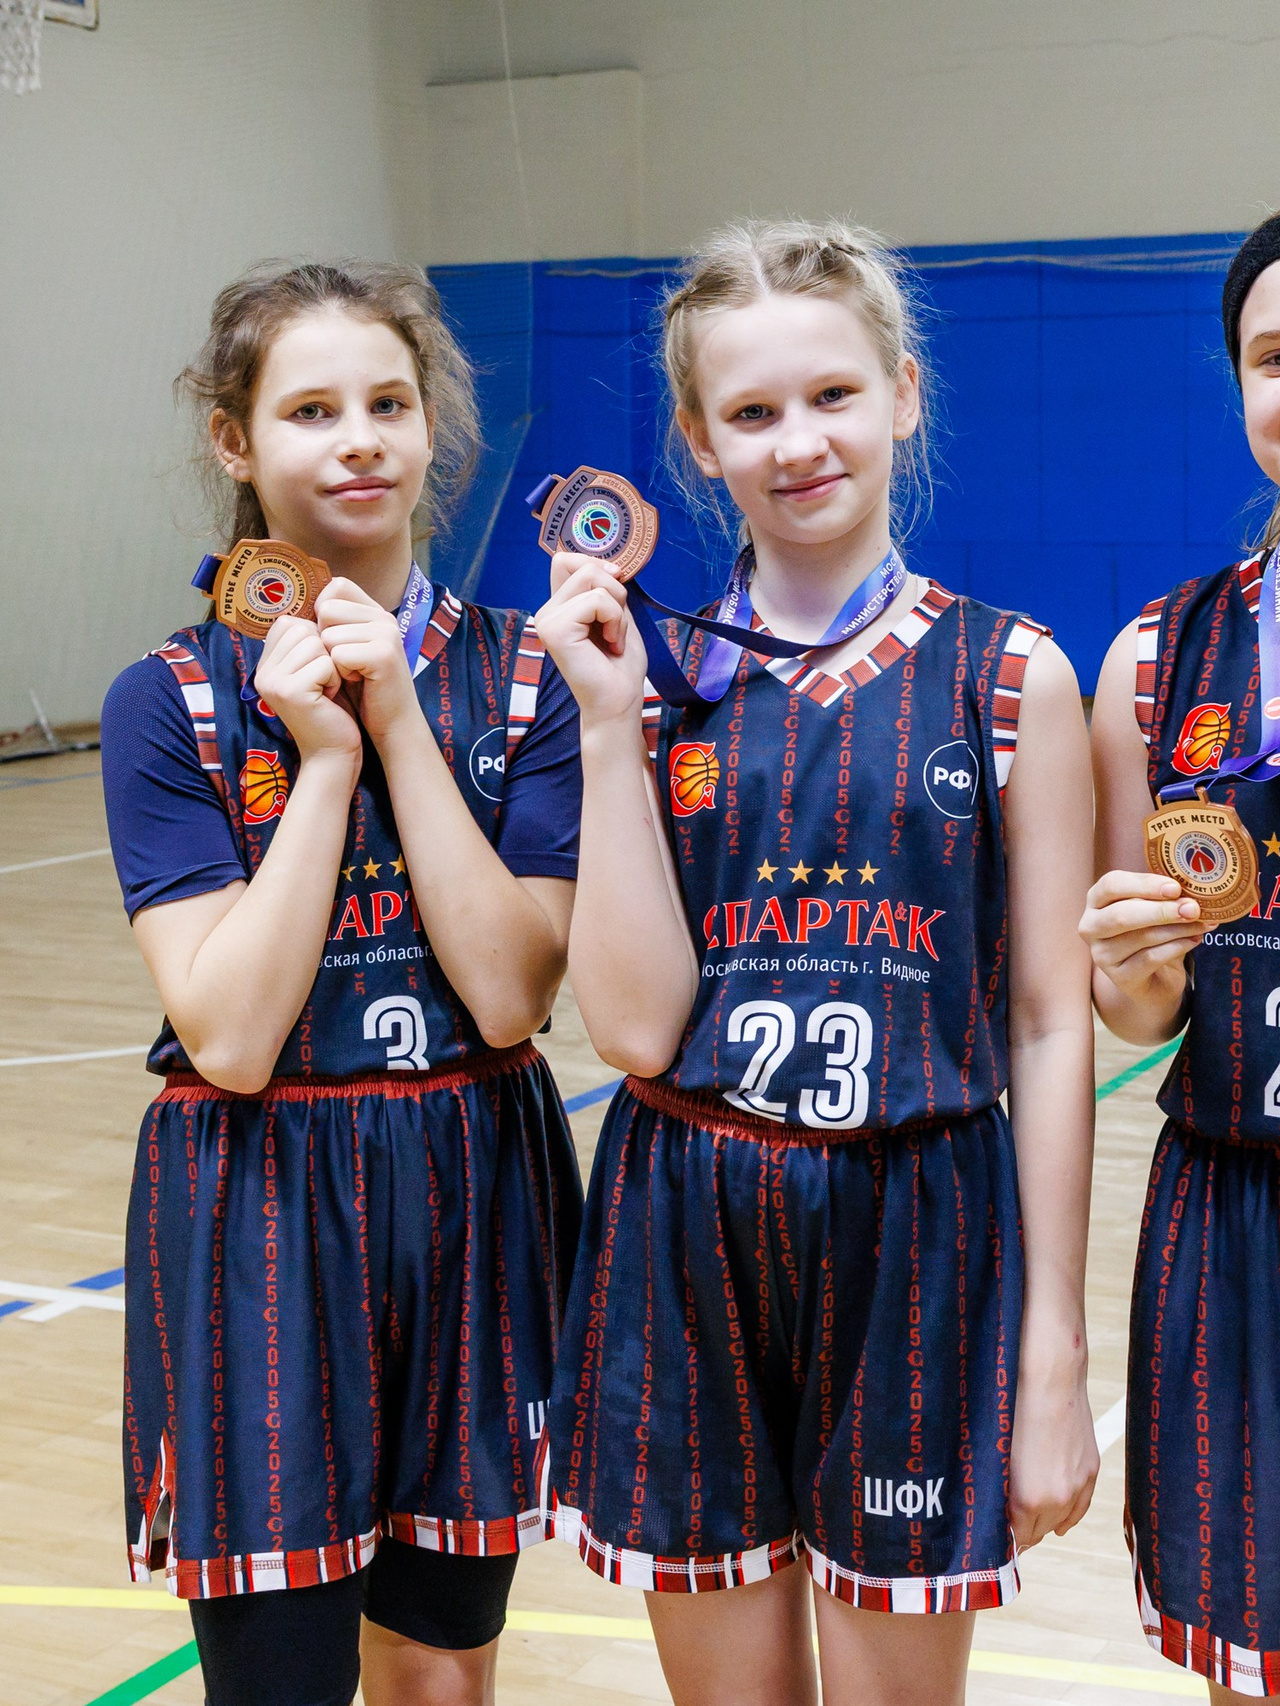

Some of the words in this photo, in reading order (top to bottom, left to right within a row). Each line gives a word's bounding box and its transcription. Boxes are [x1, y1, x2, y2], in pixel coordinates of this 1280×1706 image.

[546, 505, 565, 542] ТРЕТЬЕ
[563, 475, 588, 504] МЕСТО
[224, 580, 237, 616] ТРЕТЬЕ
[231, 548, 253, 578] МЕСТО
[841, 570, 903, 635] МИНИСТЕРСТВО
[1150, 814, 1187, 833] ТРЕТЬЕ
[1191, 814, 1226, 825] МЕСТО
[1164, 840, 1178, 875] ДЕВУШКИ
[1193, 885, 1207, 893] ЛЕТ
[786, 953, 858, 974] область
[881, 957, 931, 984] Видное
[722, 999, 875, 1130] 23
[863, 1475, 946, 1520] ШФК
